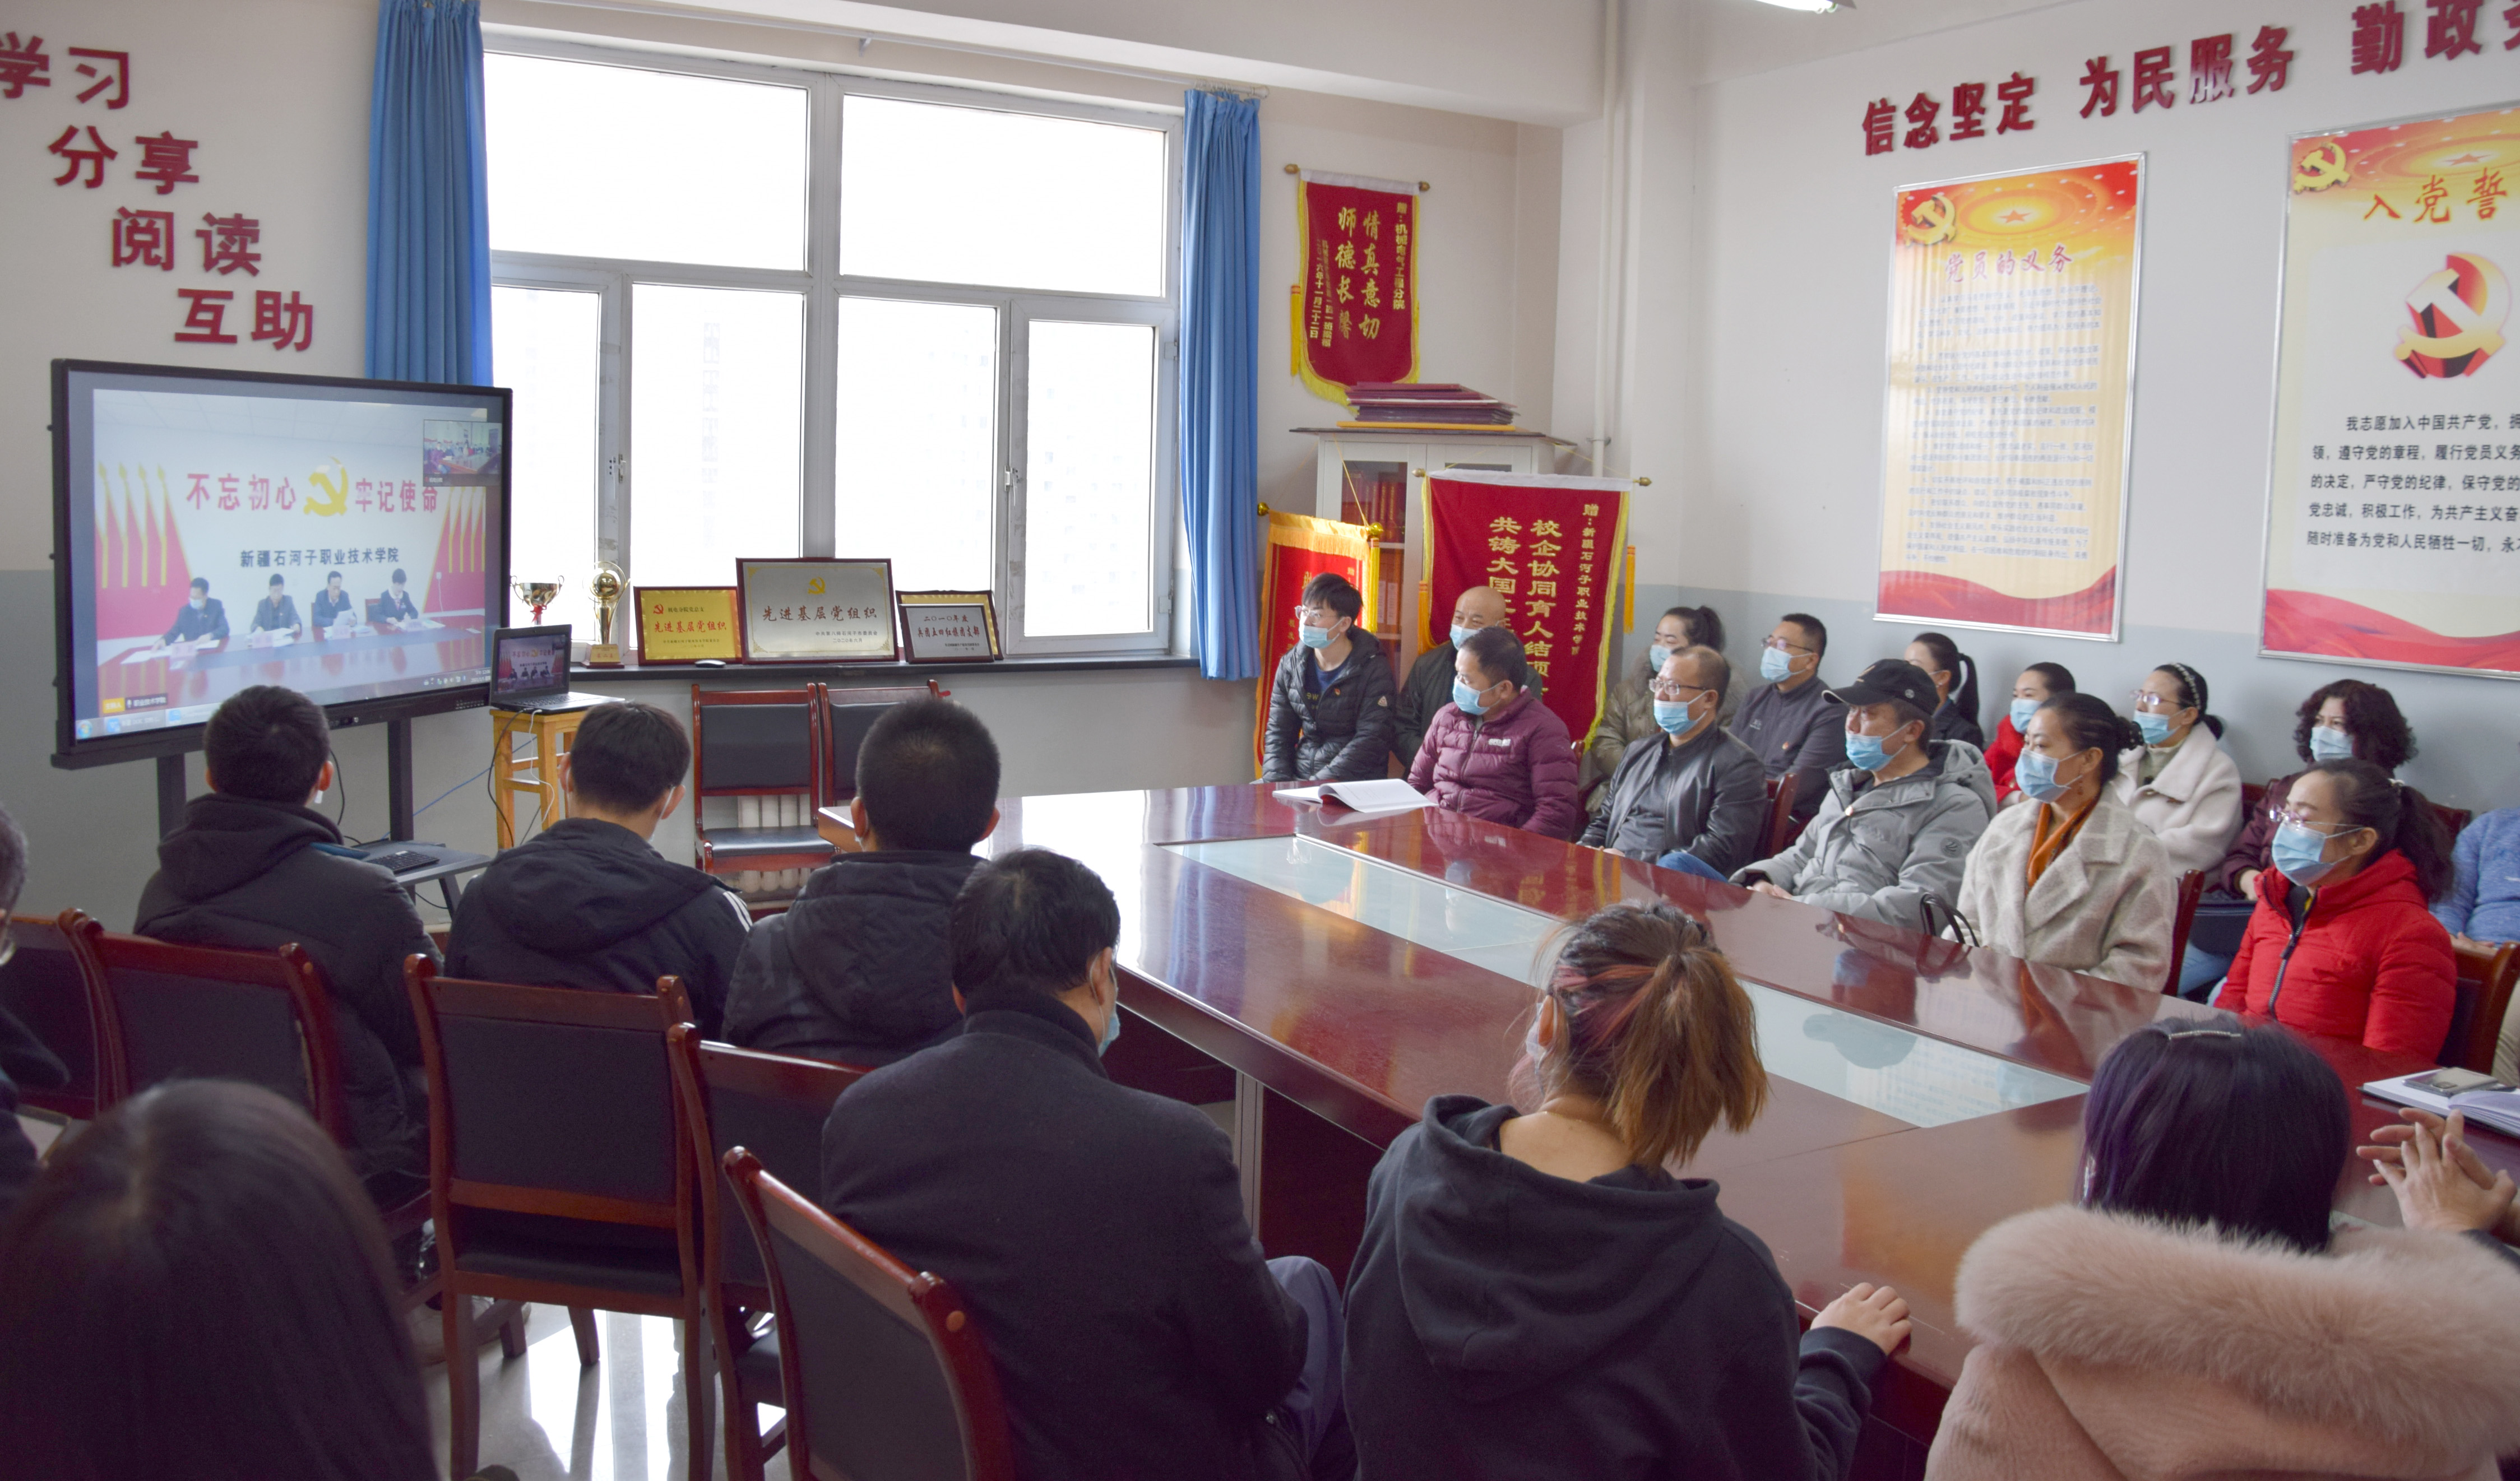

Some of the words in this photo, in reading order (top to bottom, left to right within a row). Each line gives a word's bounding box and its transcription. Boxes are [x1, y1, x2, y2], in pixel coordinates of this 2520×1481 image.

[0, 32, 130, 109] 学习
[1863, 71, 2035, 157] 信念坚定
[2079, 24, 2295, 120] 为民服务
[48, 126, 200, 195] 分享
[2364, 168, 2507, 224] 入党誓
[112, 207, 262, 277] 阅读
[1945, 243, 2072, 282] 党员的义务
[1359, 210, 1381, 340] 情真意切
[175, 288, 313, 352] 互助
[186, 473, 297, 511] 不忘初心
[355, 477, 438, 513] 牢记使命
[240, 547, 399, 568] 新疆石河子职业技术学院
[2306, 531, 2520, 553] 随时准备为党和人民牺牲一切，永
[1486, 517, 1522, 632] 共铸大国
[655, 620, 727, 633] 先进基层党组织
[762, 605, 877, 622] 先进基层党组织
